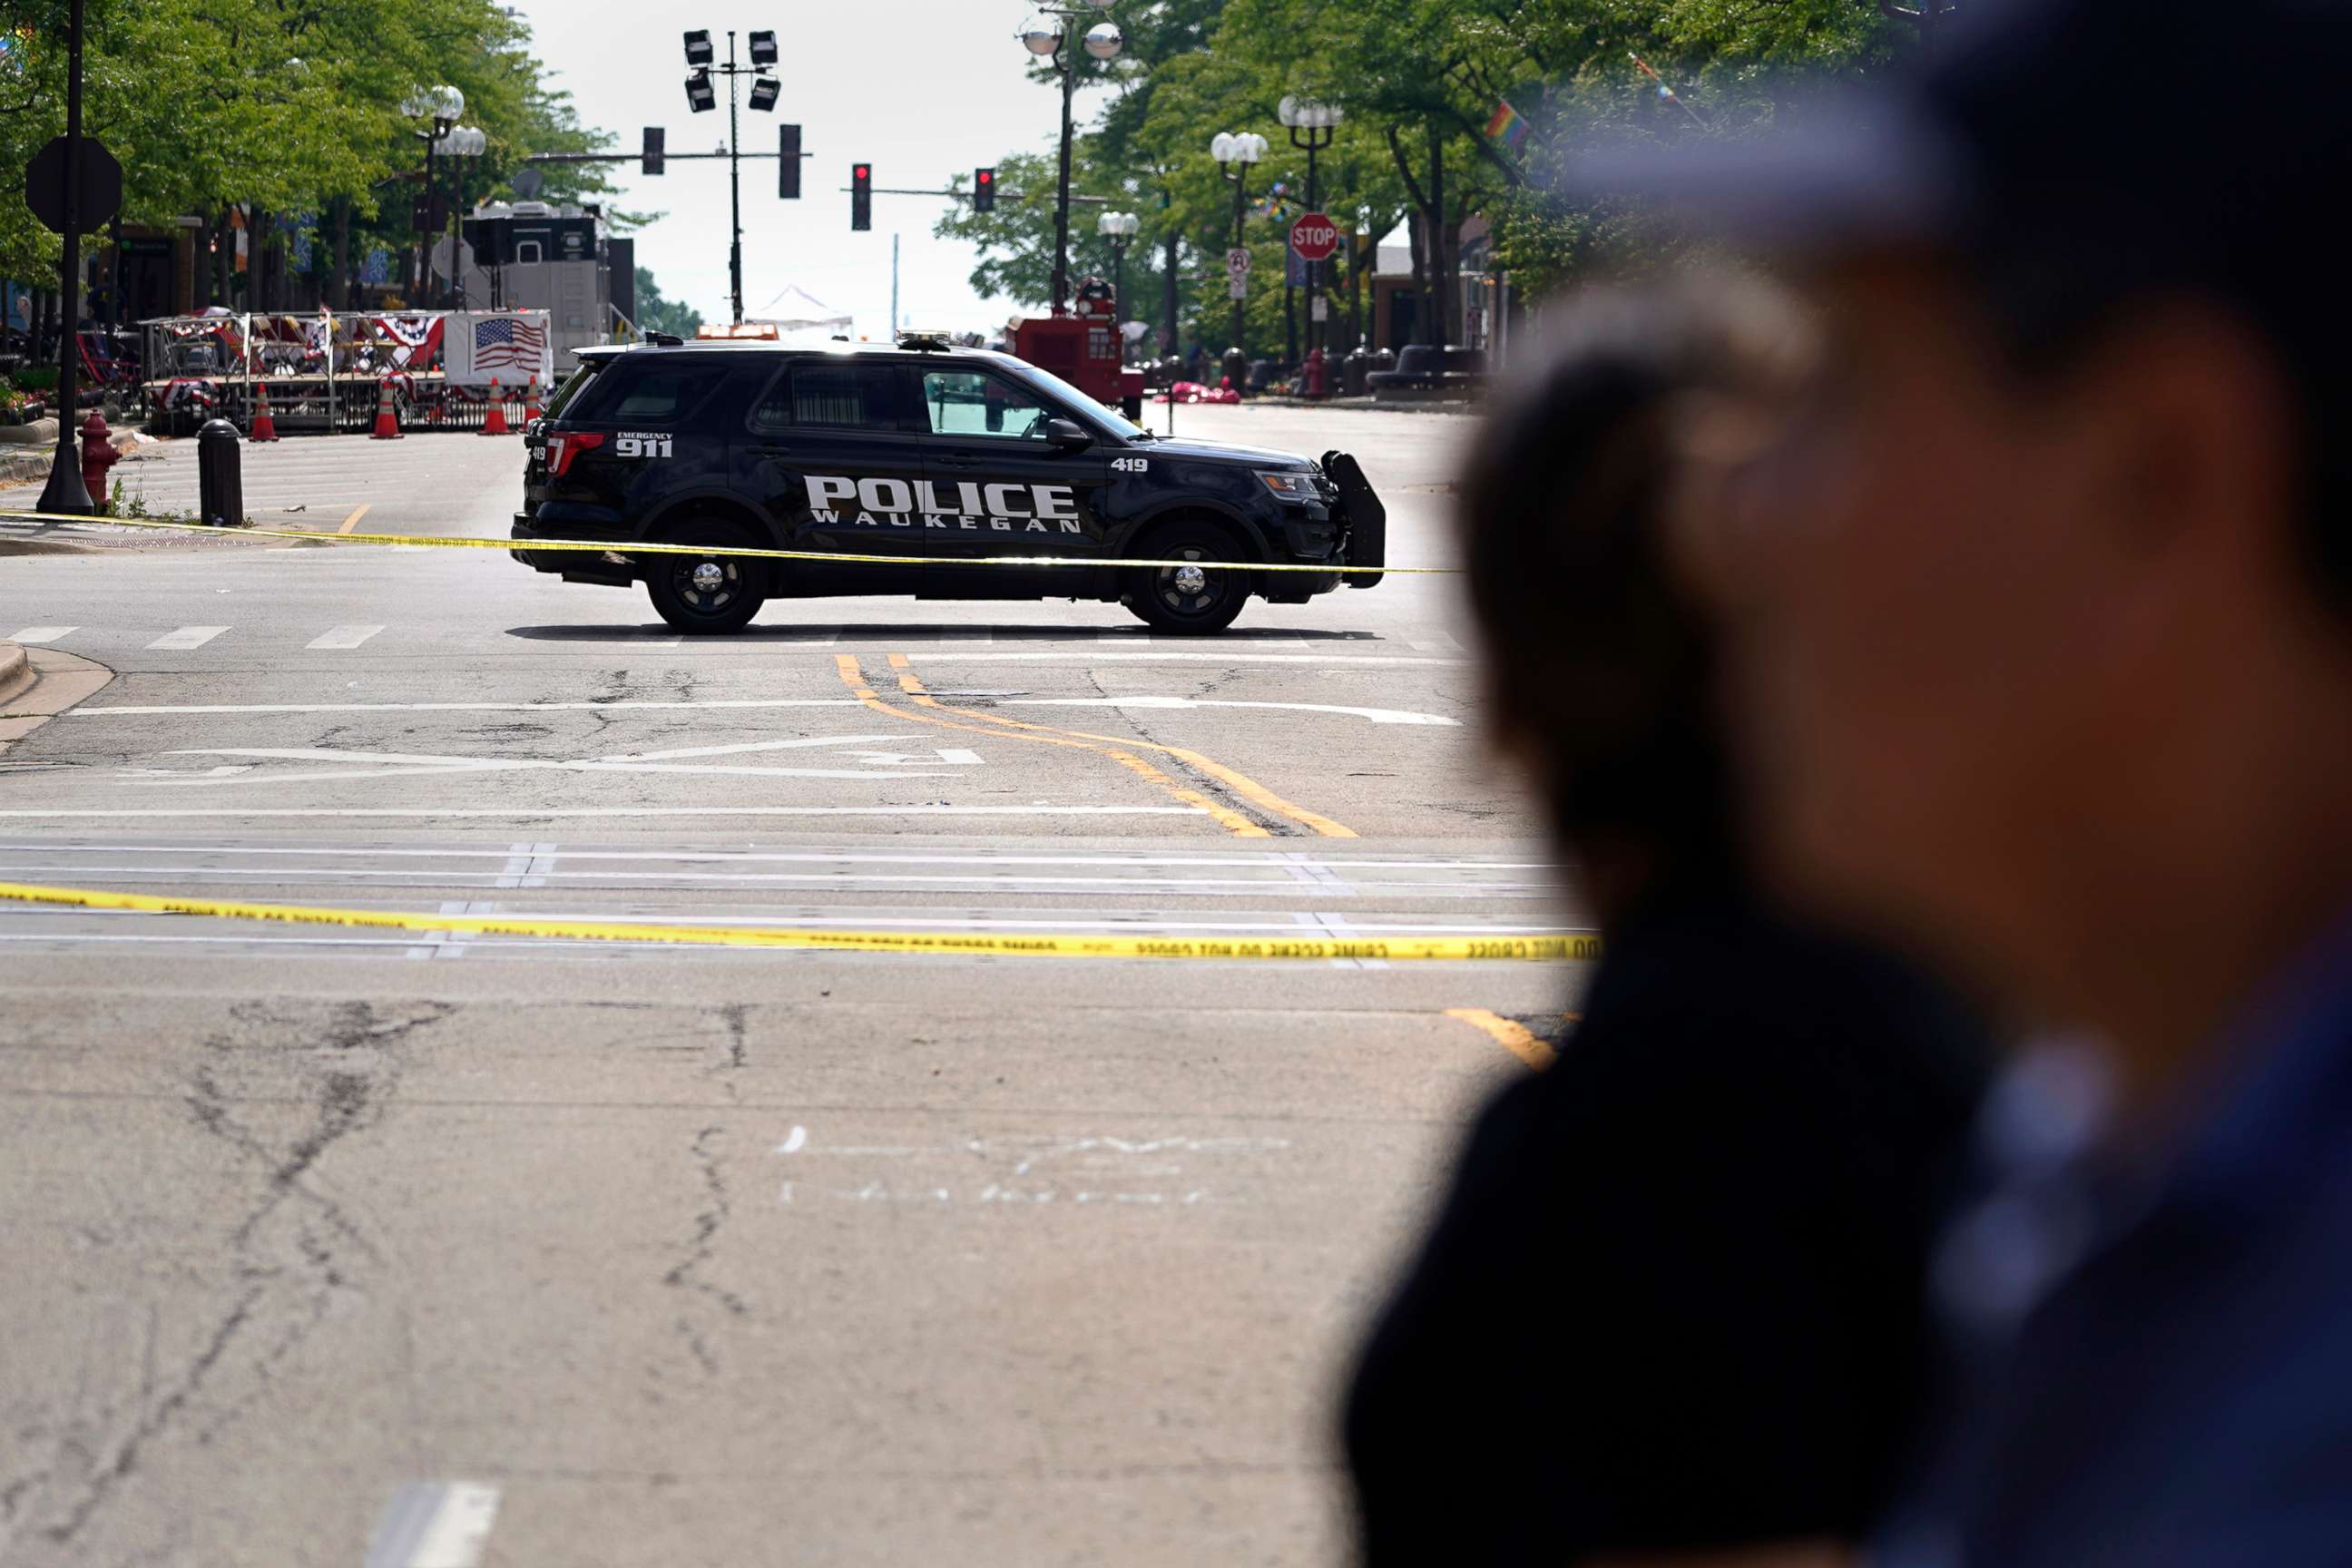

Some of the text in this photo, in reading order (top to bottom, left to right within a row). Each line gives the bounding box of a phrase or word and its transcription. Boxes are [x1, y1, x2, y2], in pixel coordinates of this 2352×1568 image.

[1295, 227, 1335, 246] STOP
[617, 431, 673, 439] EMERGENCY
[617, 439, 672, 457] 911
[1111, 457, 1148, 472] 419
[804, 475, 1079, 520] POLICE
[810, 508, 1081, 534] WAUKEGAN
